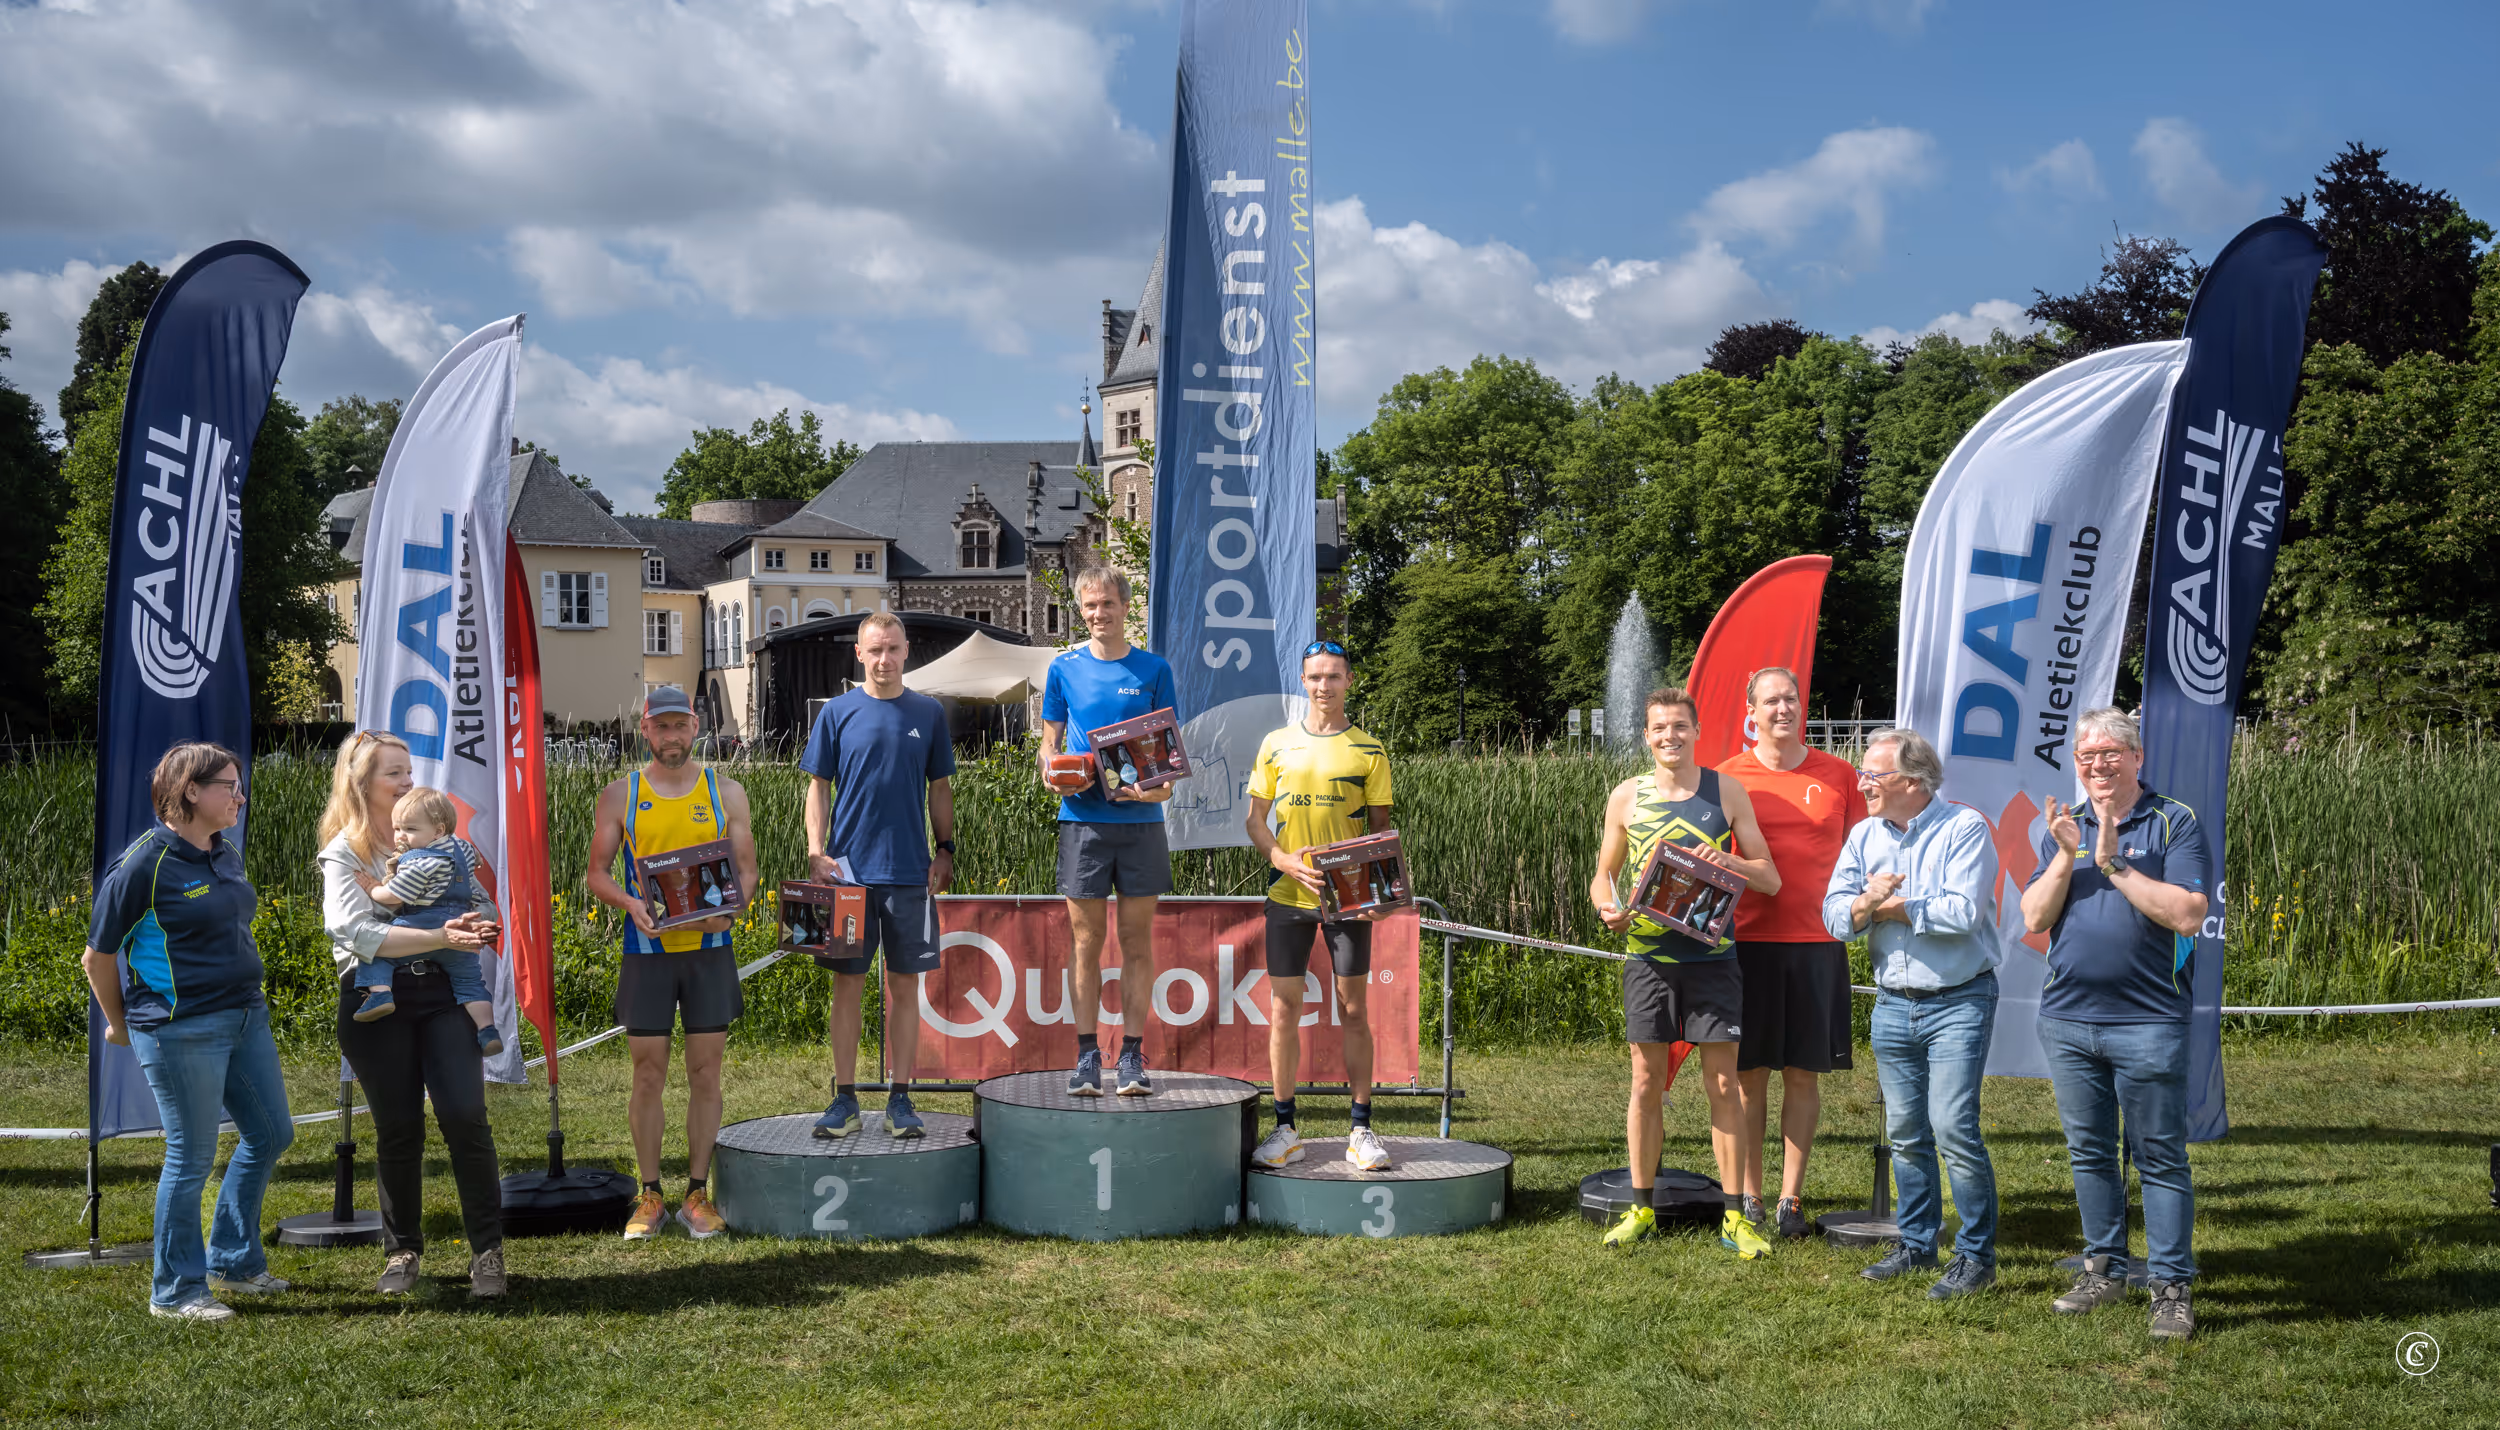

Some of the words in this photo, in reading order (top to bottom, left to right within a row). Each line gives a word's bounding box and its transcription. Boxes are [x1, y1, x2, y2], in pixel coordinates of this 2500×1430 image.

[1276, 29, 1311, 386] www.malle.be
[1183, 170, 1276, 672] sportdienst
[134, 414, 191, 623] ACHL
[2171, 409, 2225, 626] ACHL
[388, 509, 455, 763] DAL
[1951, 521, 2054, 764] DAL
[2034, 525, 2101, 771] Atletiekclub
[1096, 729, 1127, 743] Westmalle
[1289, 794, 1312, 807] J&S
[647, 857, 680, 869] Westmalle
[1320, 854, 1351, 865] Westmalle
[1663, 850, 1696, 869] Westmalle
[812, 1175, 849, 1231] 2
[1089, 1147, 1112, 1211] 1
[1361, 1185, 1396, 1238] 3
